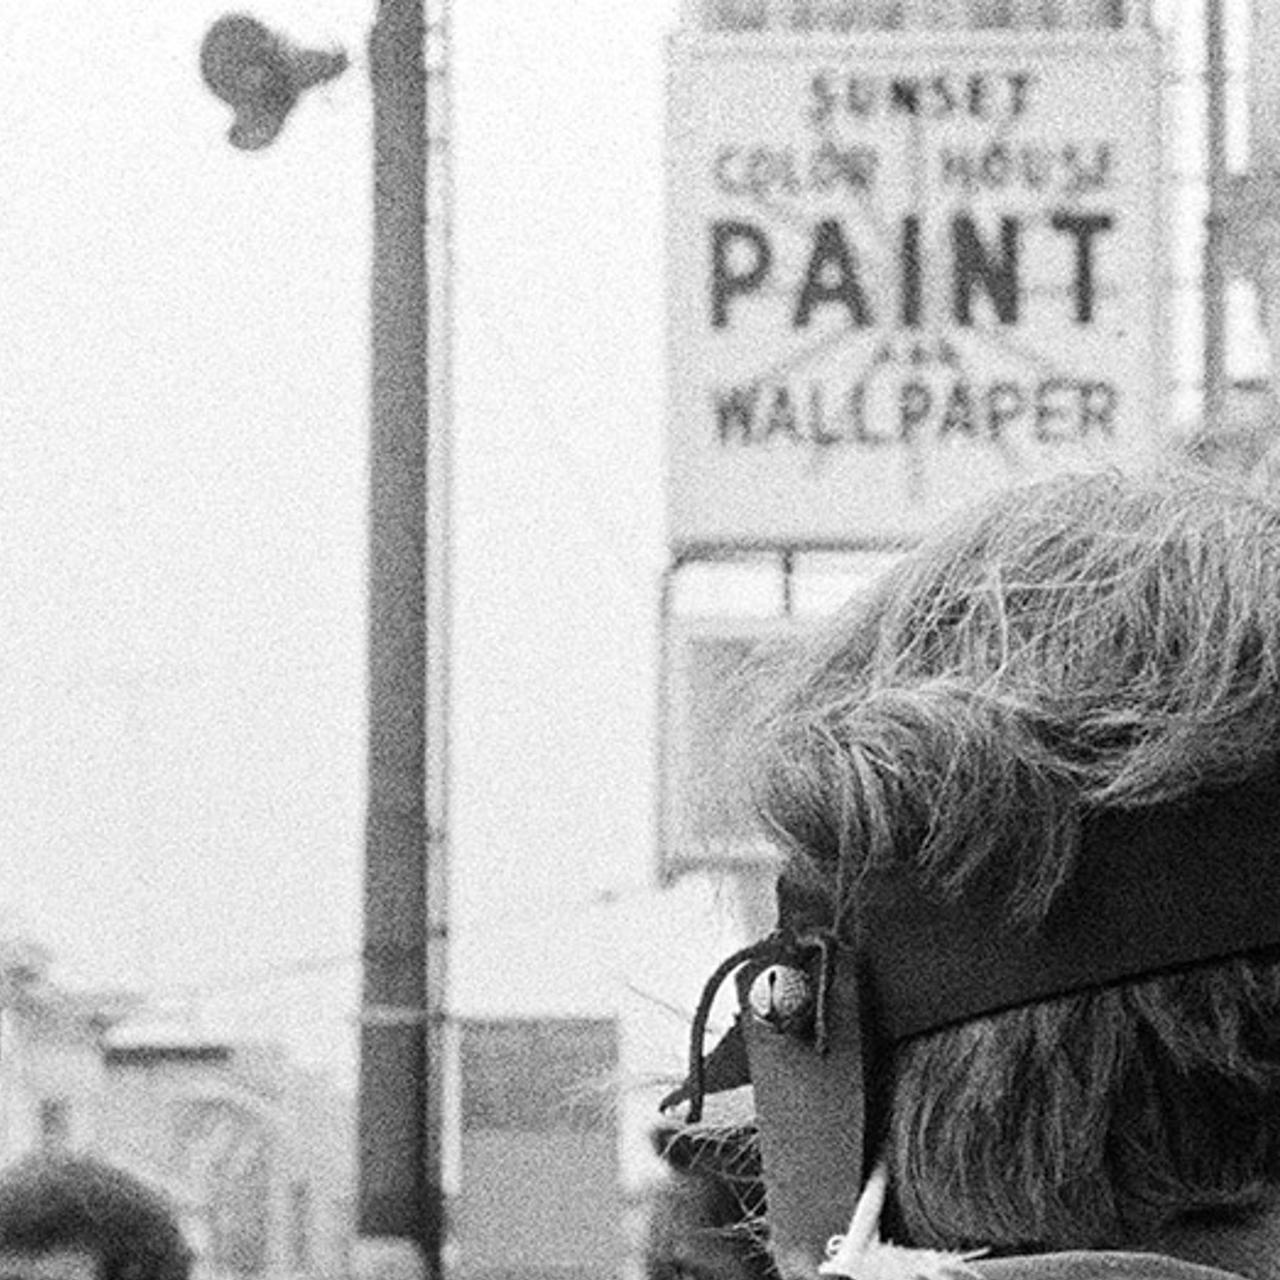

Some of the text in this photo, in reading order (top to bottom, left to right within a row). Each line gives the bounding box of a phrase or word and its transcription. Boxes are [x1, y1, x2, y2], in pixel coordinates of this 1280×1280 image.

[810, 73, 1031, 121] SUNSET
[709, 212, 1114, 329] PAINT
[714, 379, 1117, 446] WALLPAPER
